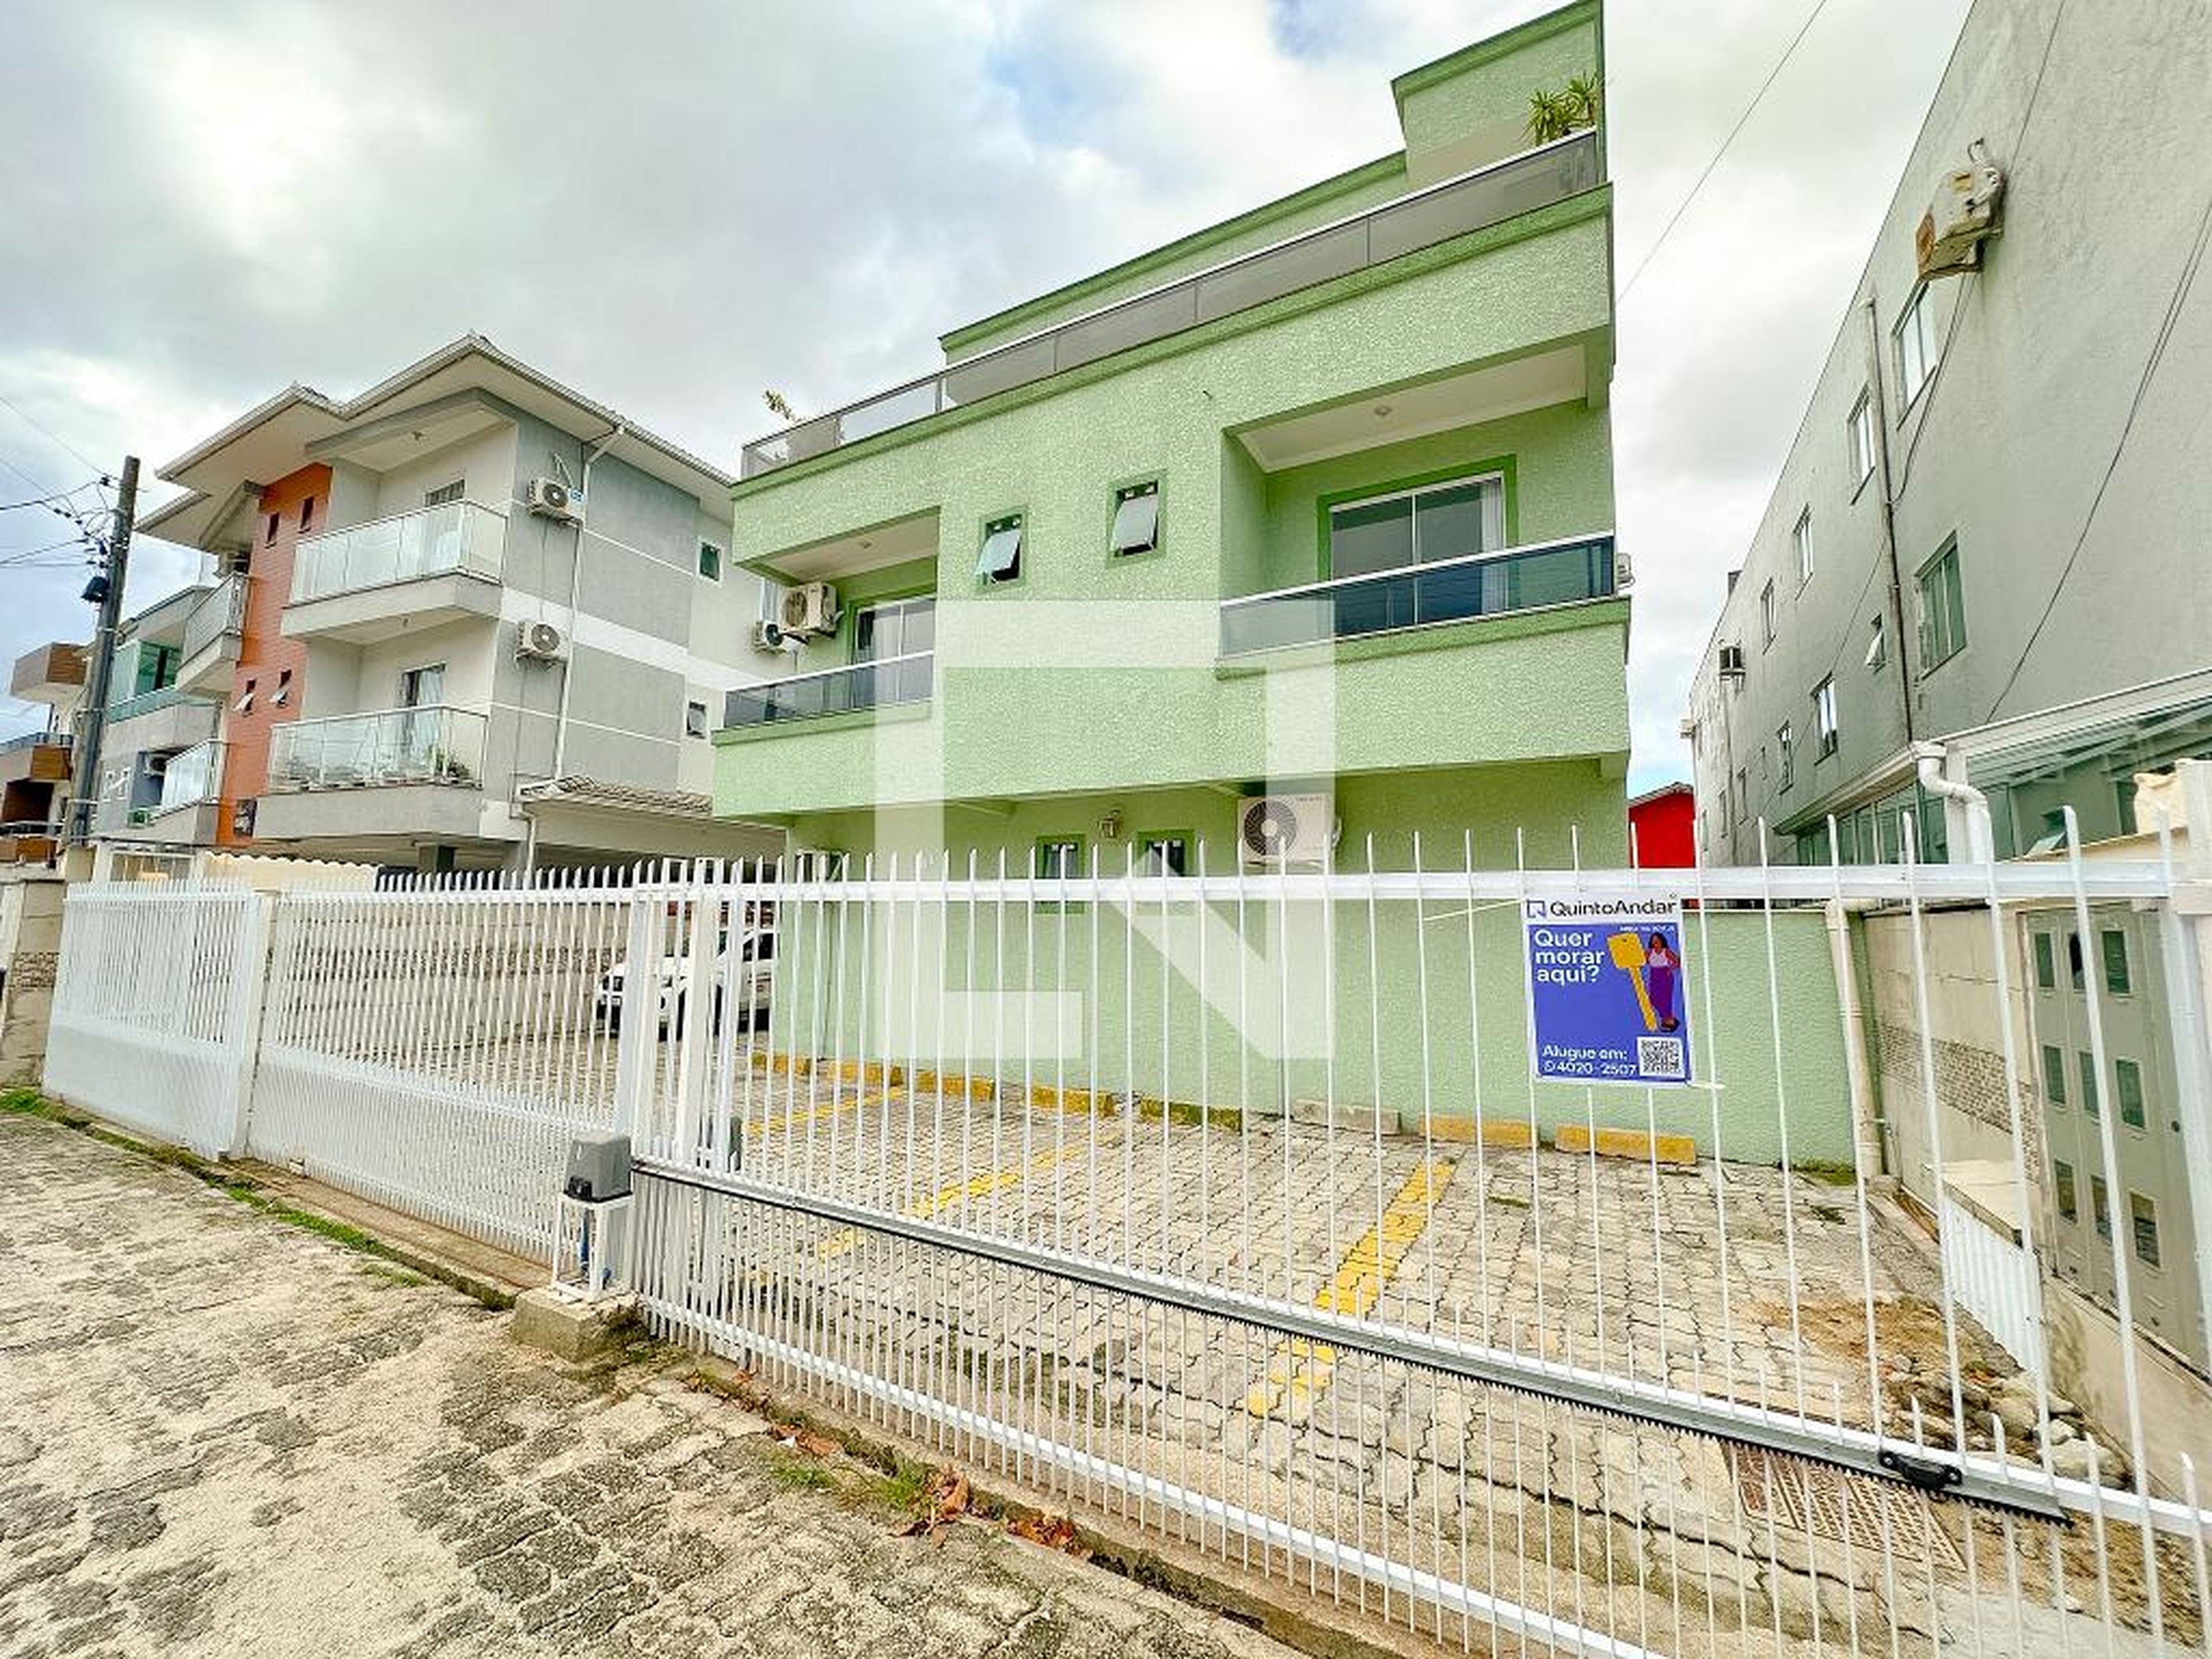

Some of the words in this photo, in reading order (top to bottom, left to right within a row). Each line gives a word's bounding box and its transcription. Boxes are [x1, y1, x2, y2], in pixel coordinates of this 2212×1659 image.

[1550, 899, 1677, 917] QuintoAndar
[1535, 930, 1592, 948] Quer
[1535, 950, 1605, 965] morar
[1537, 965, 1600, 986] aqui?
[1542, 1044, 1597, 1062] Alugue
[1599, 1049, 1628, 1060] em:
